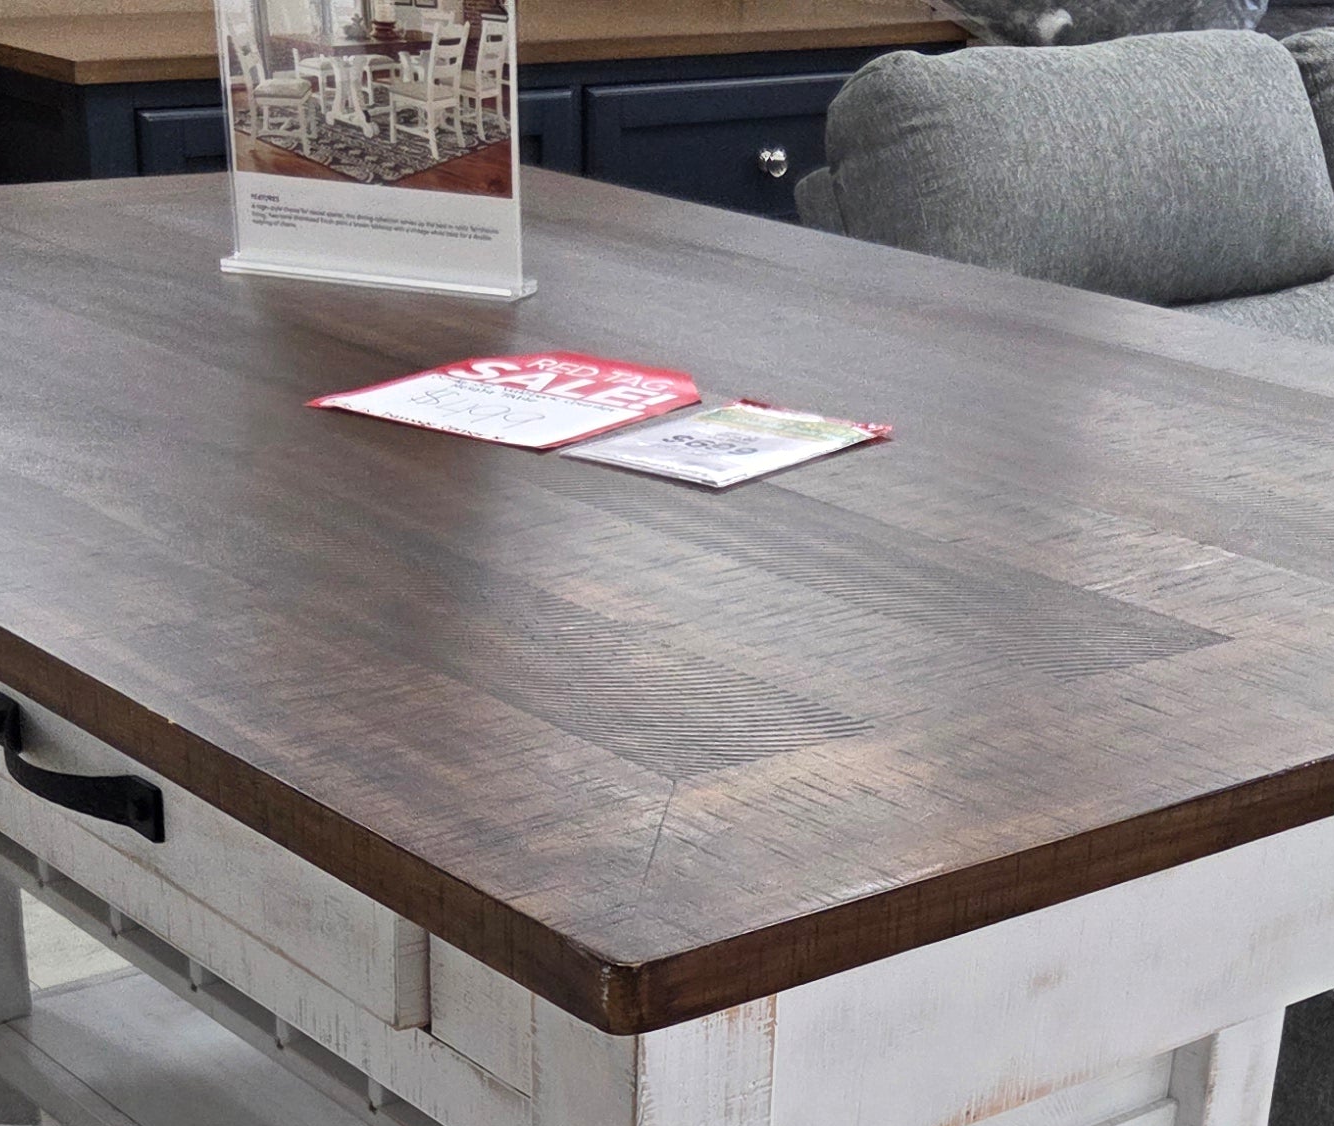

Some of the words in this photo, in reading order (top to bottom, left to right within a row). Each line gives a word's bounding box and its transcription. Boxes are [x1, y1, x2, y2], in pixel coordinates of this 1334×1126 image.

[446, 361, 679, 411] SALE!
[525, 358, 599, 379] RED
[609, 370, 674, 391] TAG
